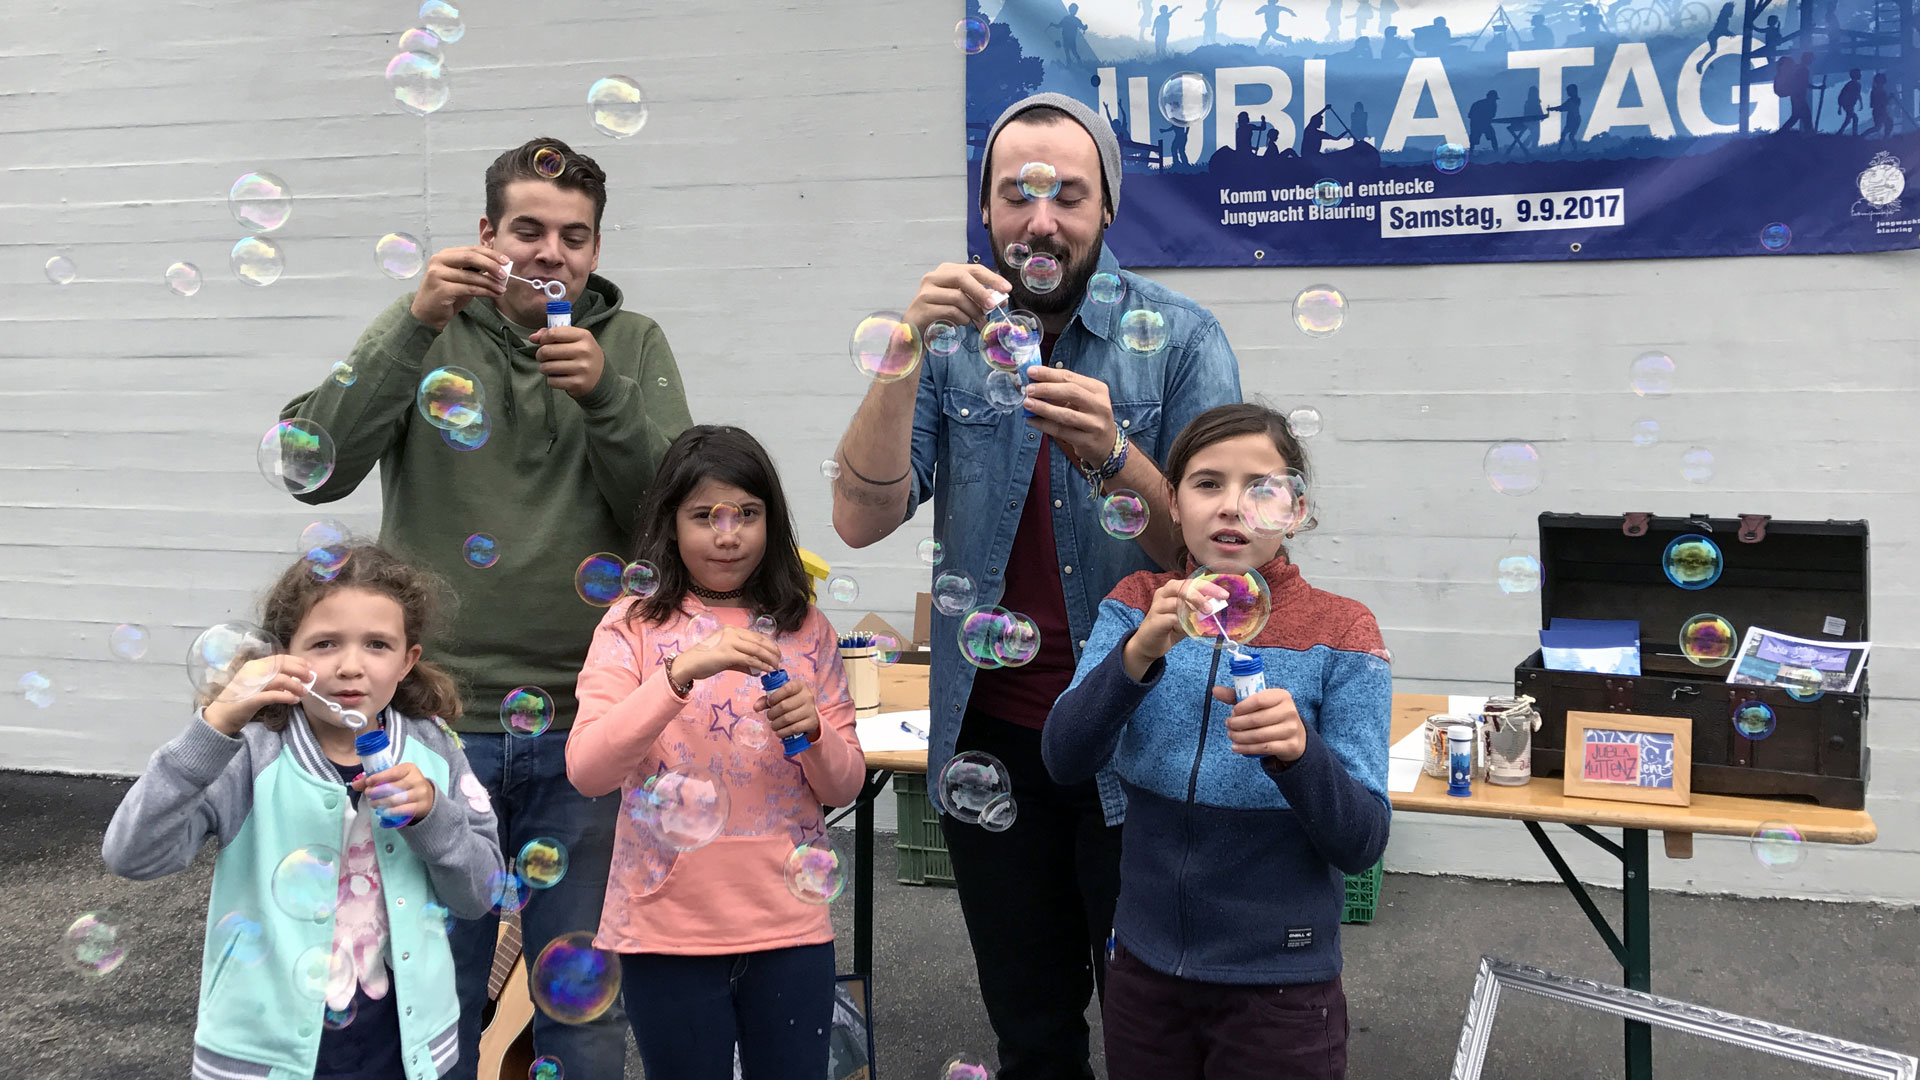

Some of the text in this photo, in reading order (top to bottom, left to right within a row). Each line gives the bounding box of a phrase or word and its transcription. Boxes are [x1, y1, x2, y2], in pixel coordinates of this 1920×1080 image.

[1507, 35, 1780, 147] TAG
[1220, 178, 1435, 204] Komm vorbei und entdecke
[1220, 202, 1375, 227] Jungwacht Blauring
[1389, 195, 1620, 231] Samstag, 9.9.2017
[1876, 226, 1912, 234] blauring
[1592, 744, 1631, 760] JUBLA
